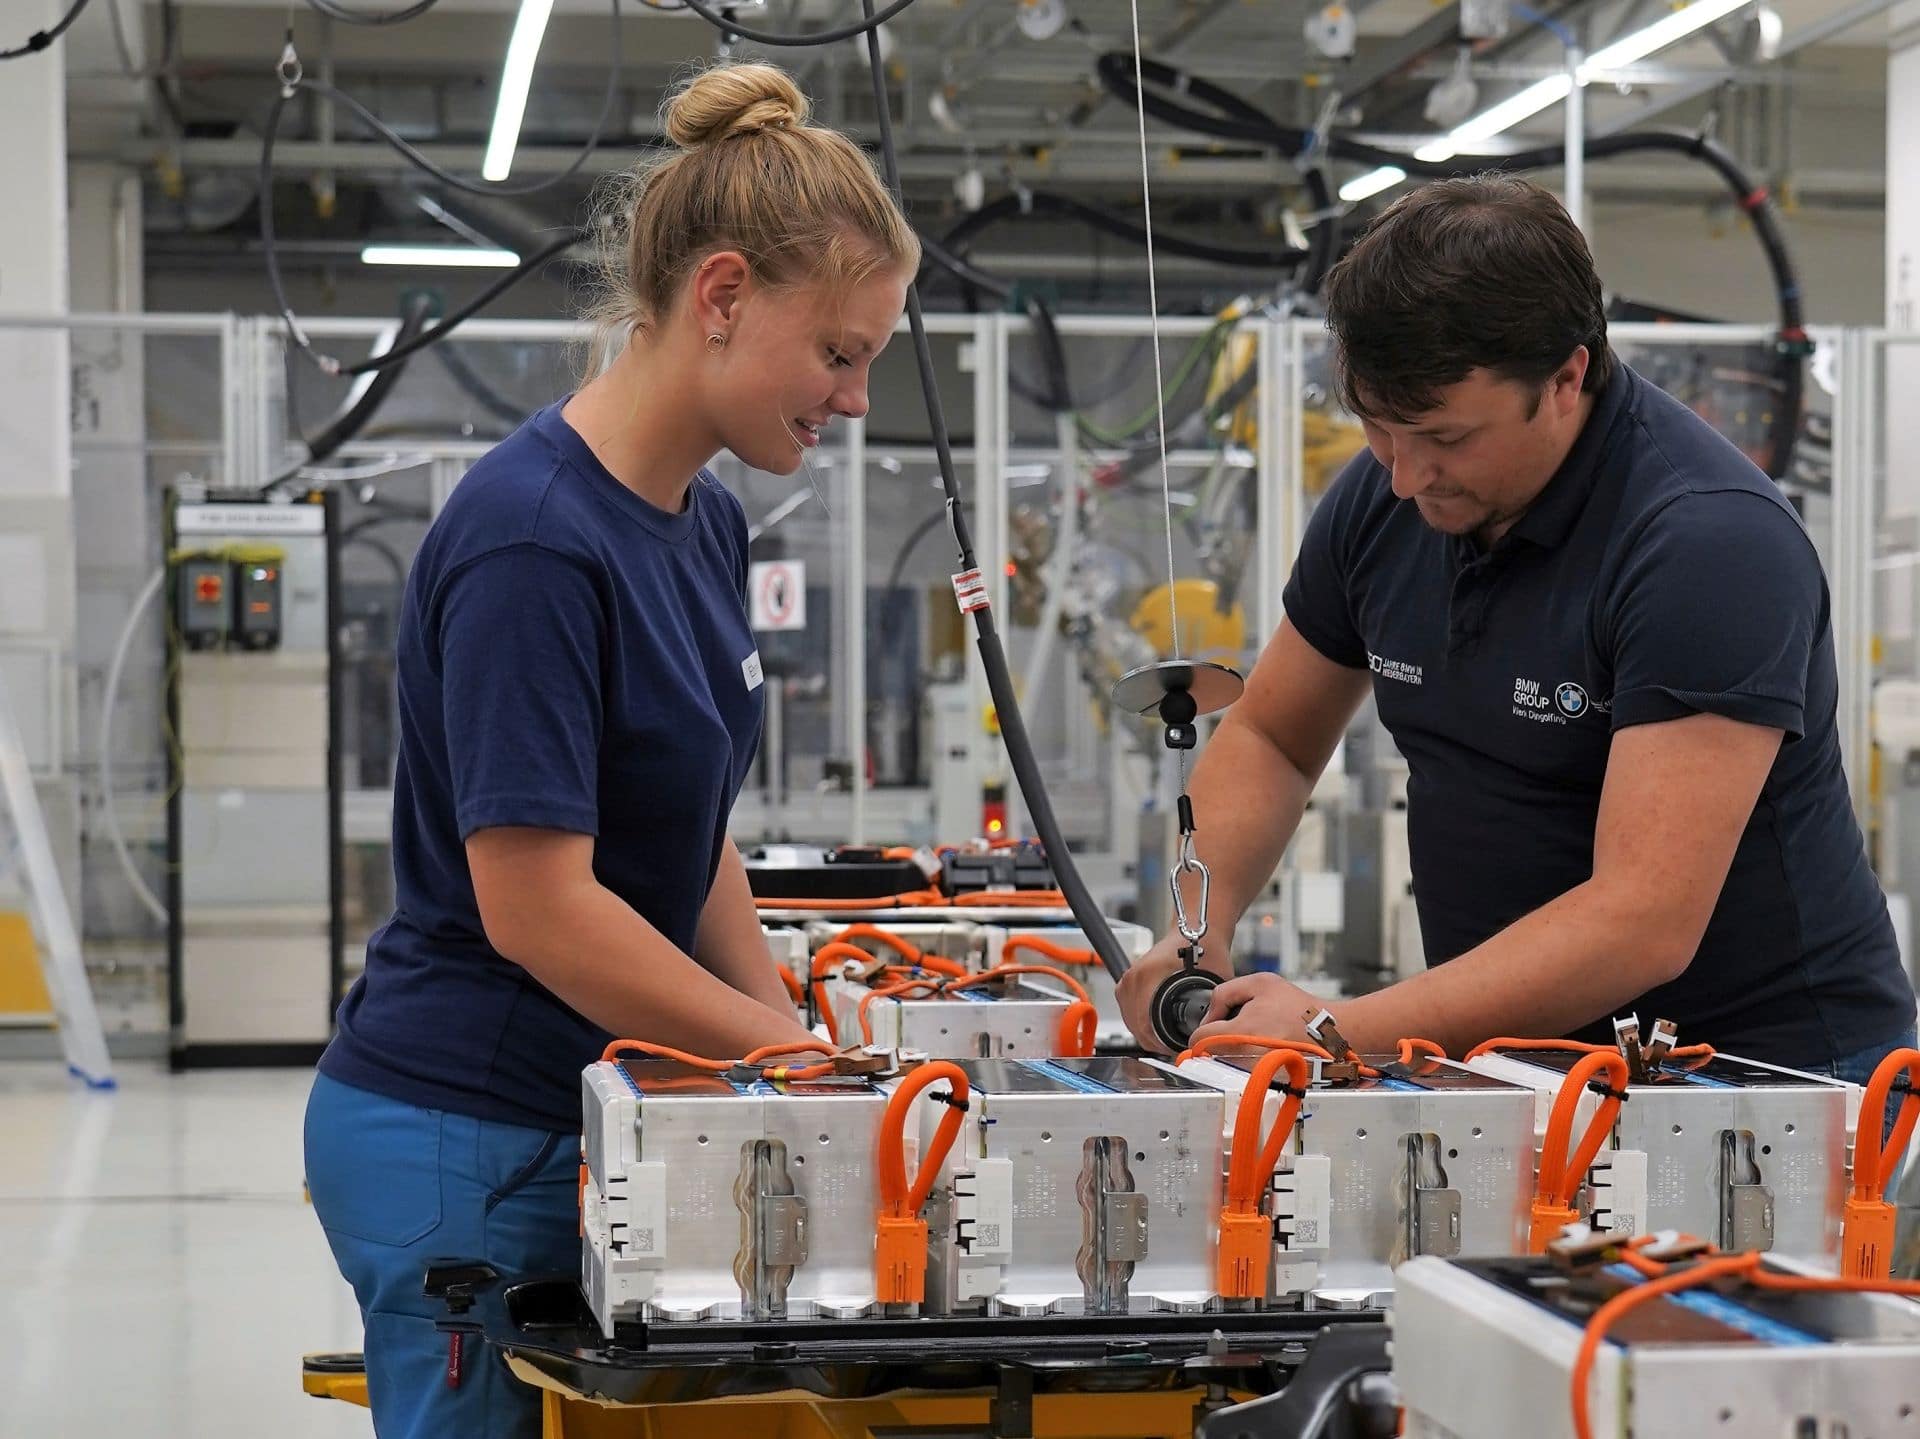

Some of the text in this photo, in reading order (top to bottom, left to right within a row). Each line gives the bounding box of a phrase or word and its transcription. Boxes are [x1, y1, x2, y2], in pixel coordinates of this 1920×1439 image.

[1515, 678, 1540, 695] BMW
[1513, 691, 1549, 709] GROUP
[1528, 710, 1567, 725] Dingolfing
